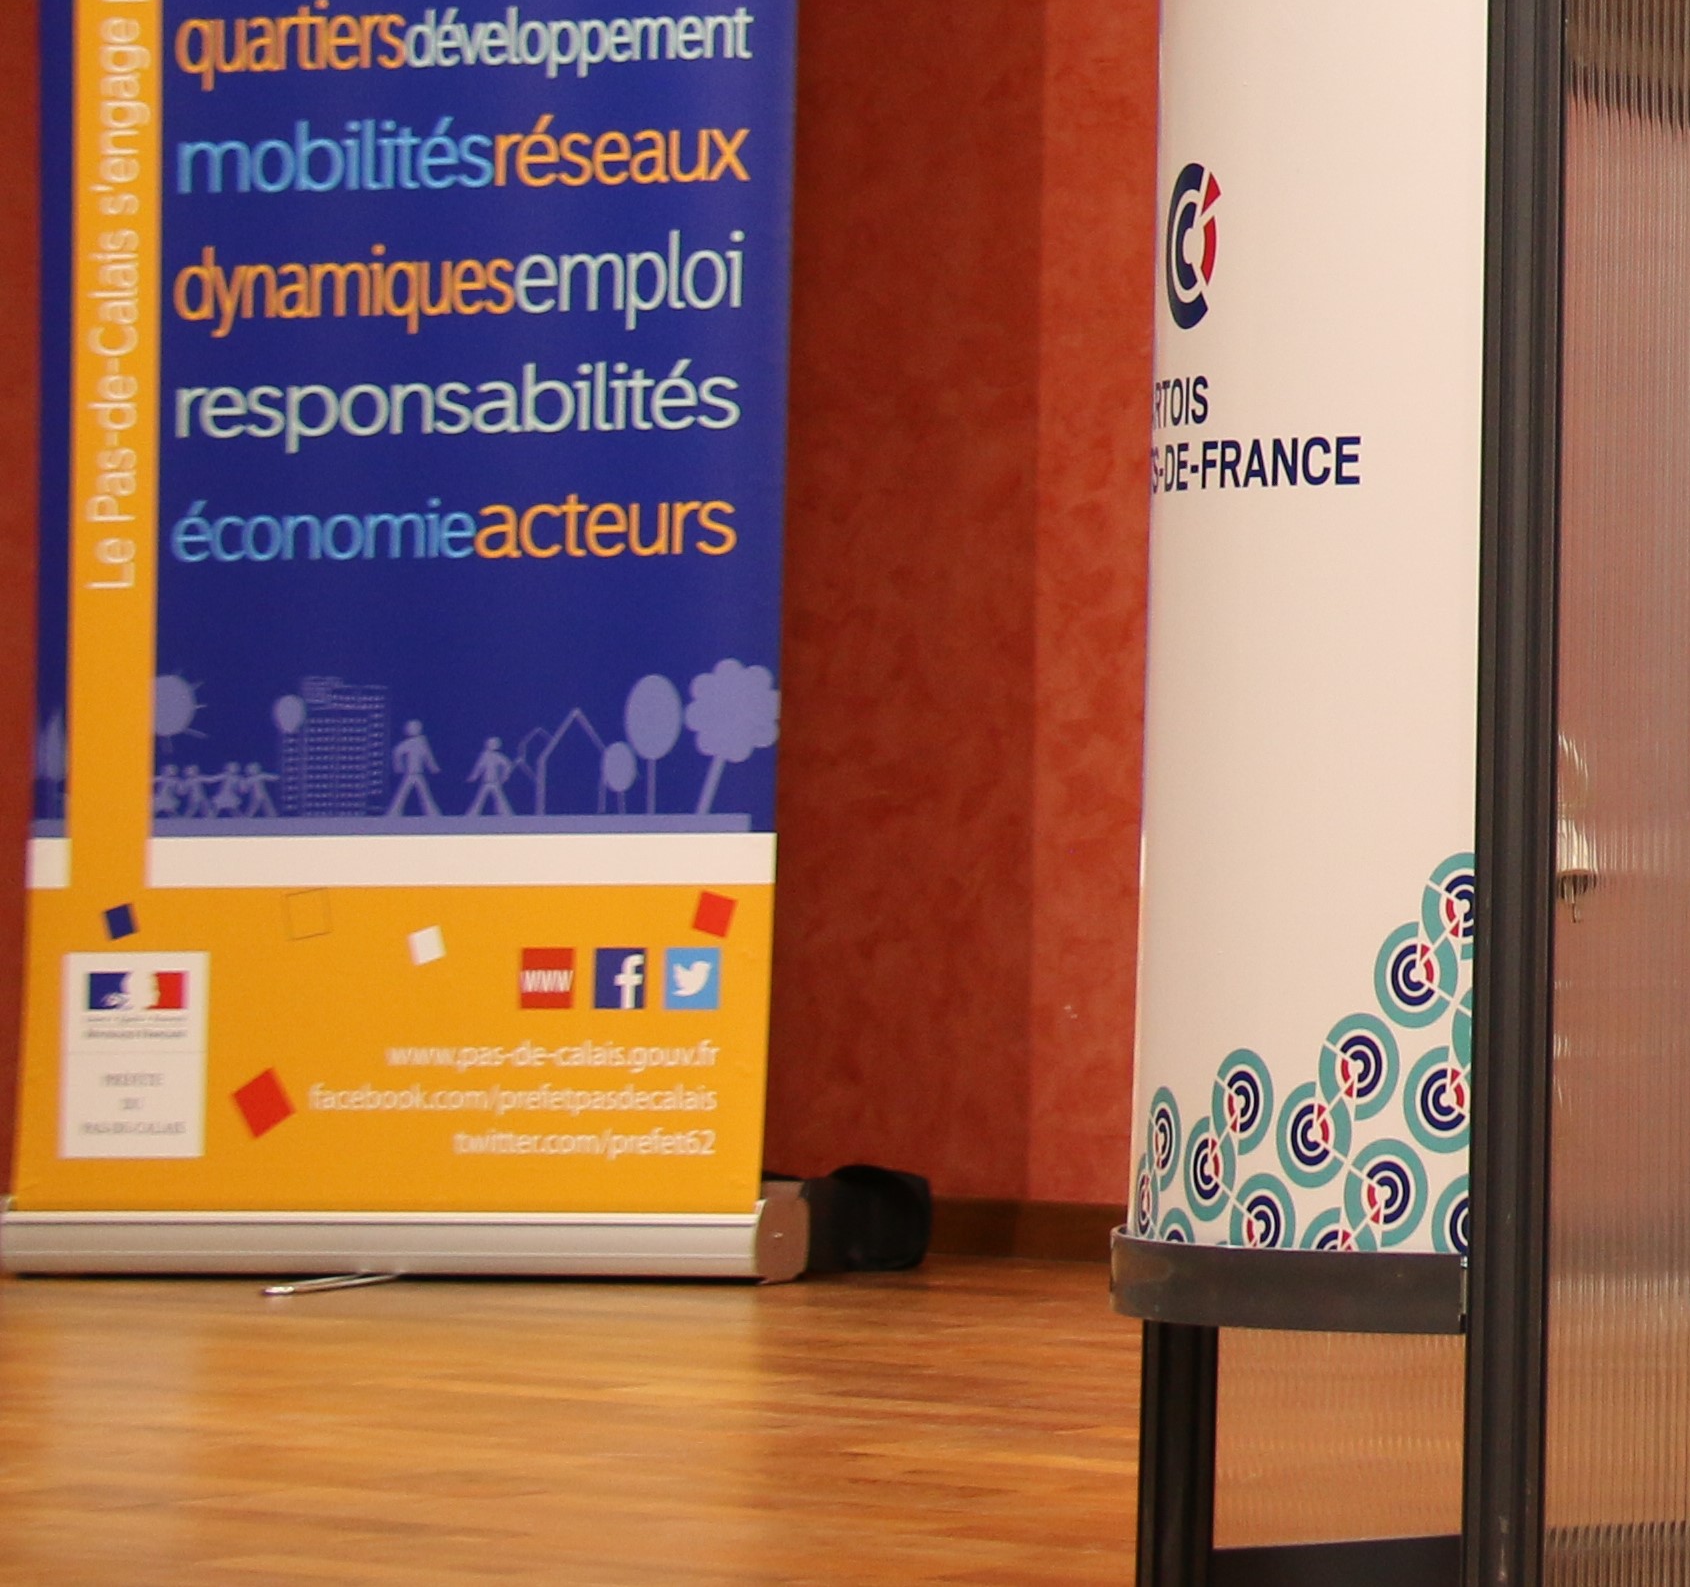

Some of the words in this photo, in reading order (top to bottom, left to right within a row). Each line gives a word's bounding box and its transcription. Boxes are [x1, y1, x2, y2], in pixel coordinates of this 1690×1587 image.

[89, 17, 153, 215] s'engage
[85, 228, 141, 524] Pas-de-Calais
[1153, 375, 1209, 430] RTOIS
[175, 358, 741, 454] responsabilités
[1151, 436, 1361, 494] S-DE-FRANCE
[84, 538, 137, 592] Le
[385, 1039, 721, 1072] www.pas-de-calais.gouv.fr
[307, 1082, 718, 1116] facebook.com/prefetpasdecalais
[452, 1128, 718, 1160] twitter.com/prefet62
